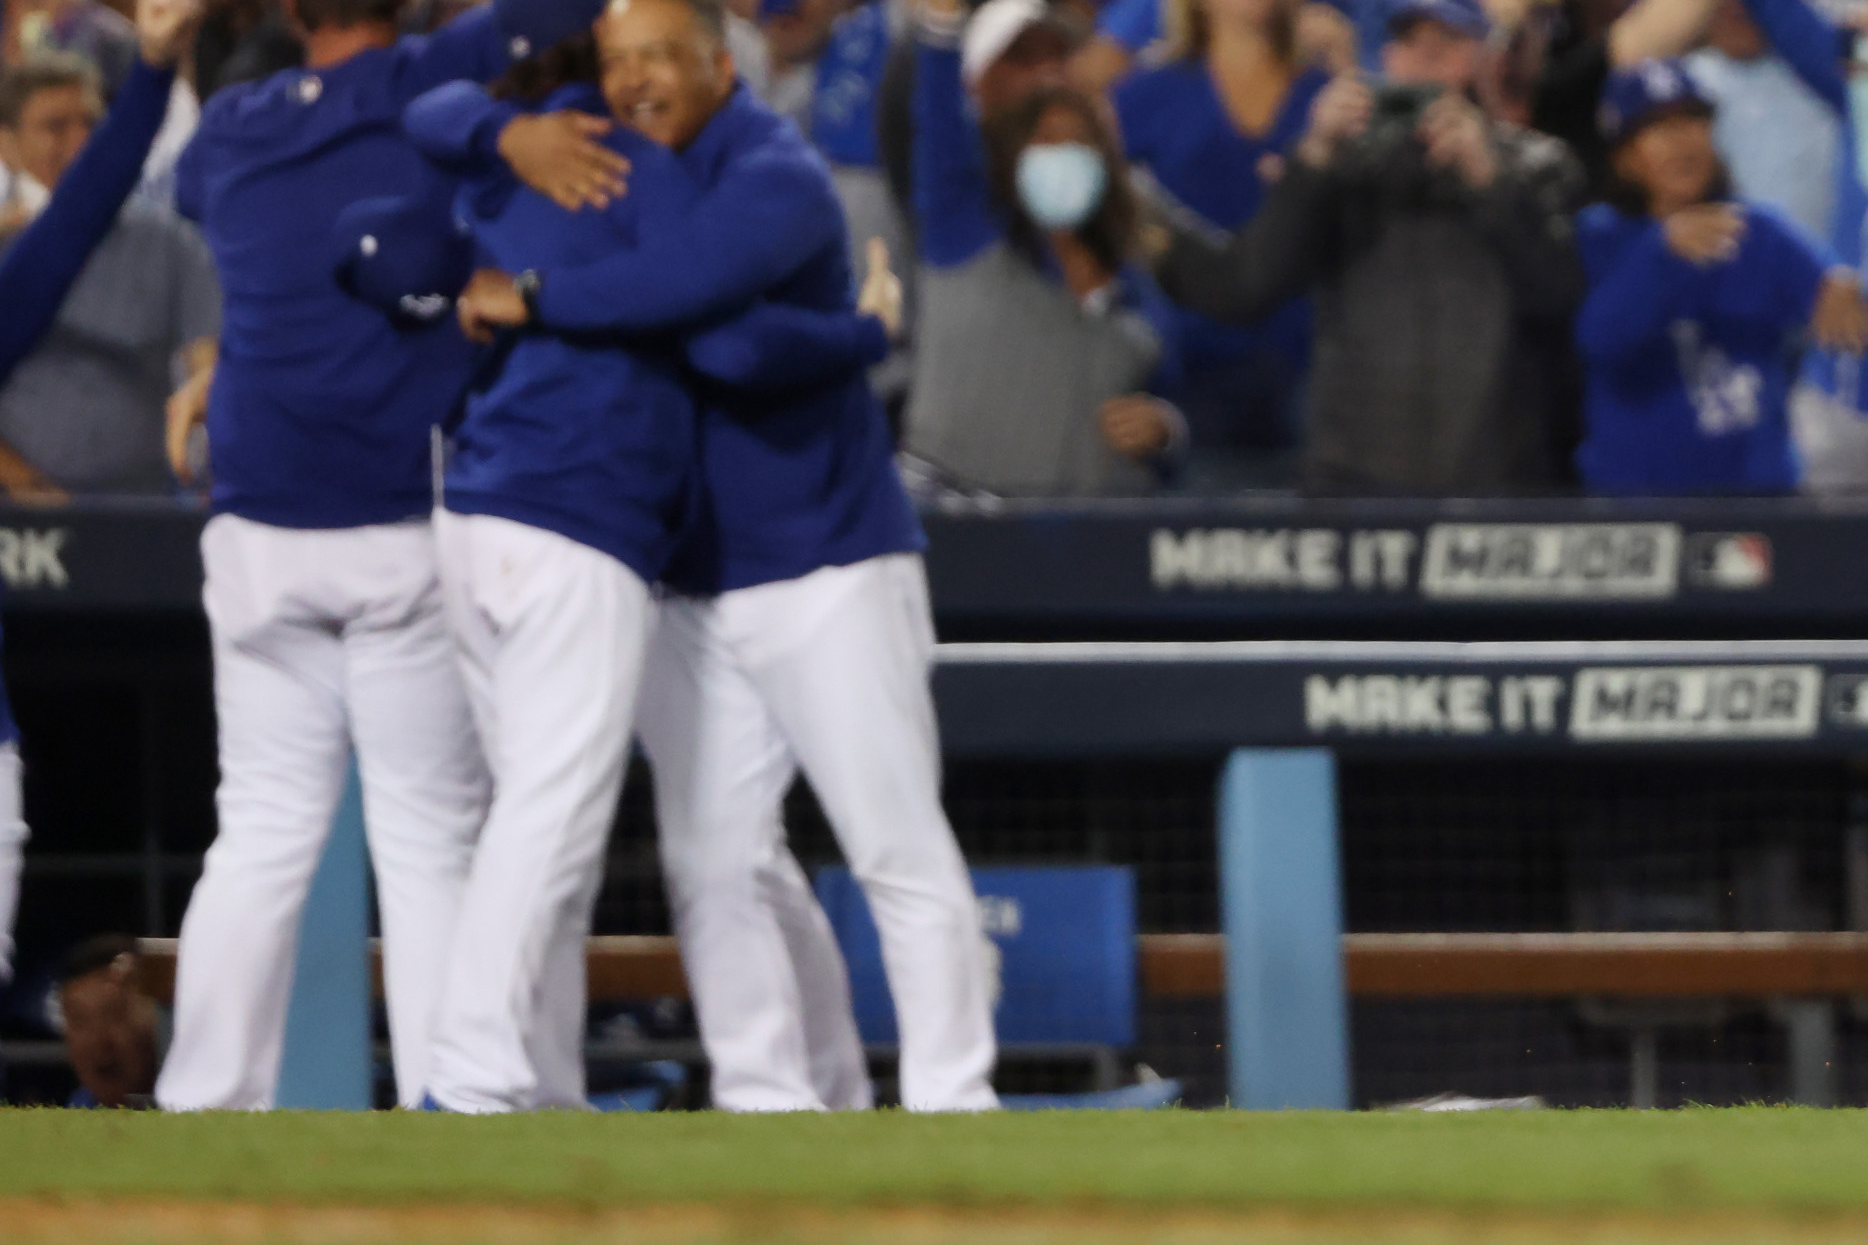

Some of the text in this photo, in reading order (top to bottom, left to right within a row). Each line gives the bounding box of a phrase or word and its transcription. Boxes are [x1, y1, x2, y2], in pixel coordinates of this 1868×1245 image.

[1150, 527, 1666, 592] MAKE IT MAJOR
[1303, 673, 1806, 734] MAKE IT MAJOR
